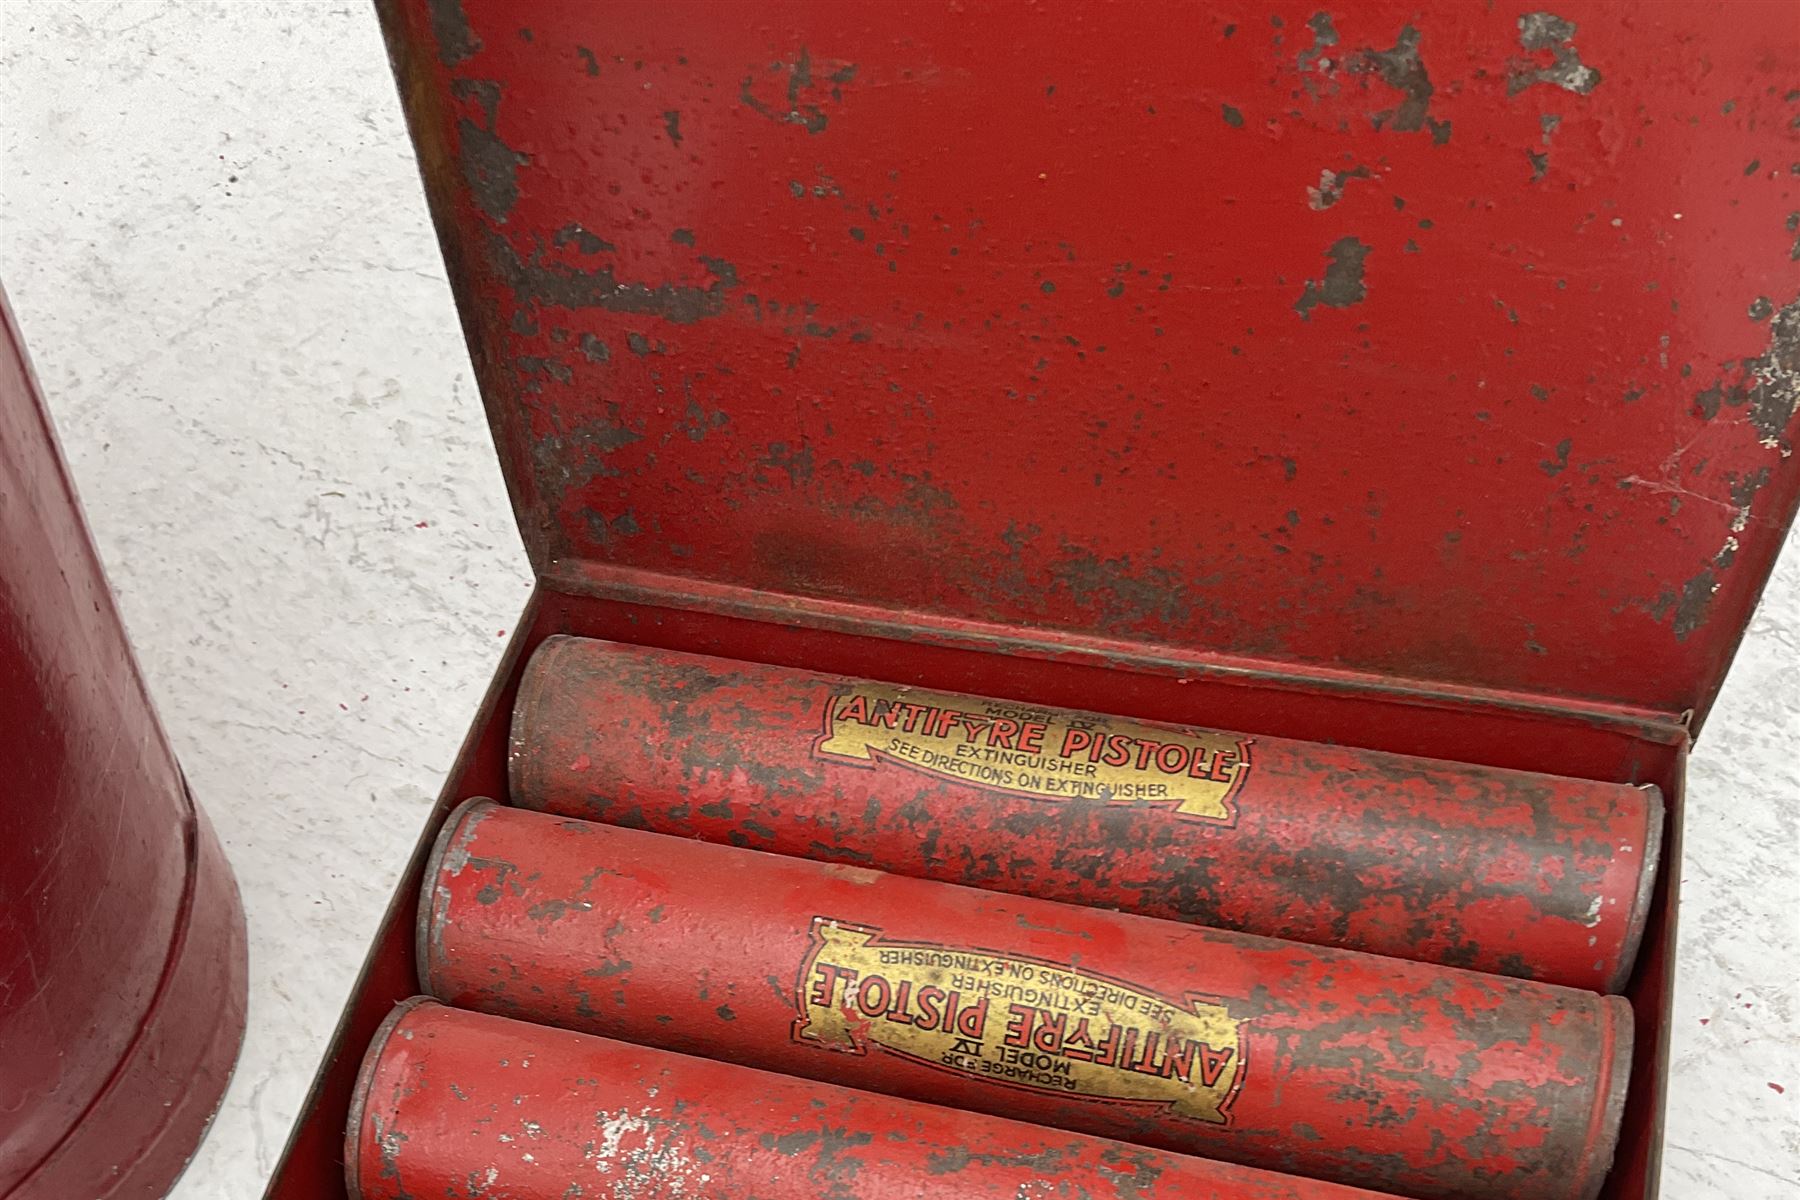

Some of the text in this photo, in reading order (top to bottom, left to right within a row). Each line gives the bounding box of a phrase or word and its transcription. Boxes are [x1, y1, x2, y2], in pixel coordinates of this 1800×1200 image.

[836, 695, 1236, 783] ANTIFYRE PISTOLE
[985, 707, 1097, 731] MODEL IV
[888, 738, 1168, 798] SEE DIRECTIONS ON EXTINGUISHER
[956, 744, 1097, 778] EXTINGUISHER
[879, 951, 1176, 1024] SEE DIRECTIONS ON EXTINGUISHER
[952, 974, 1099, 1016] EXTINGUISHER
[811, 962, 1235, 1088] ANTIFYRE PISTOLE
[942, 1052, 1076, 1091] RECHARGE FOR
[950, 1037, 1072, 1075] MODEL IV
